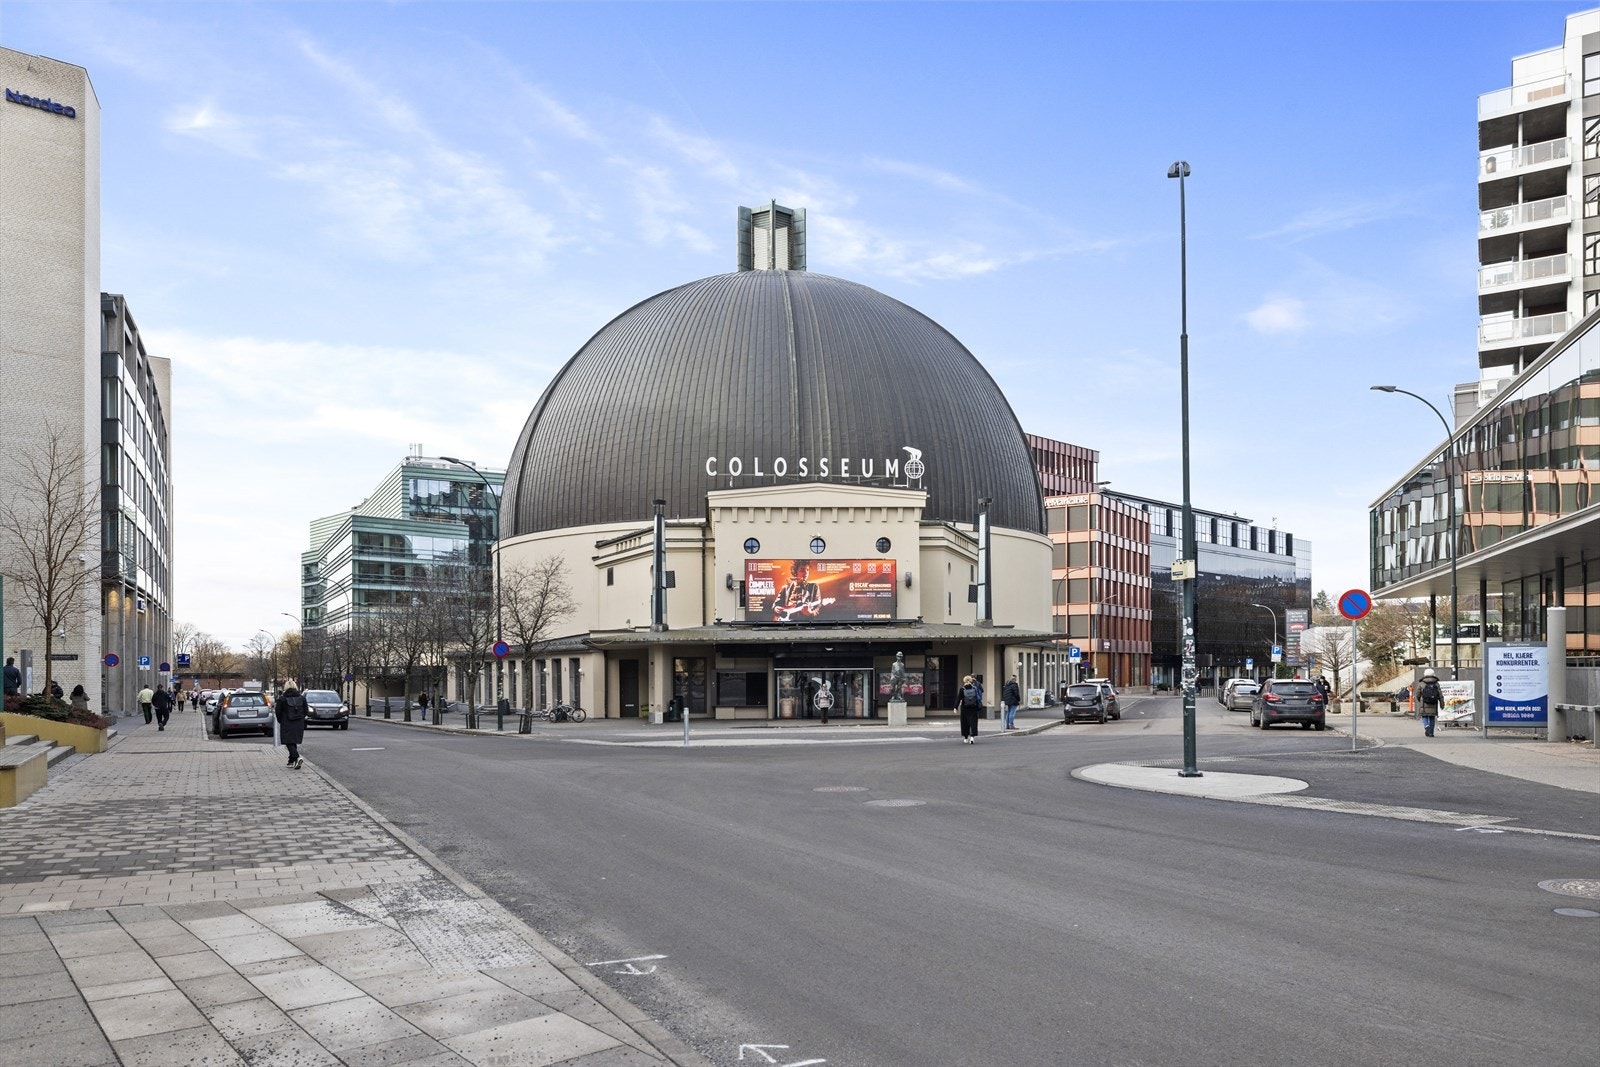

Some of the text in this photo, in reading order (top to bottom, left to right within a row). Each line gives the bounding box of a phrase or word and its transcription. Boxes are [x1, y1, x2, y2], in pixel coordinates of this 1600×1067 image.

[6, 88, 76, 118] Nordea
[705, 456, 900, 479] COLOSSEUM
[1071, 648, 1078, 656] P
